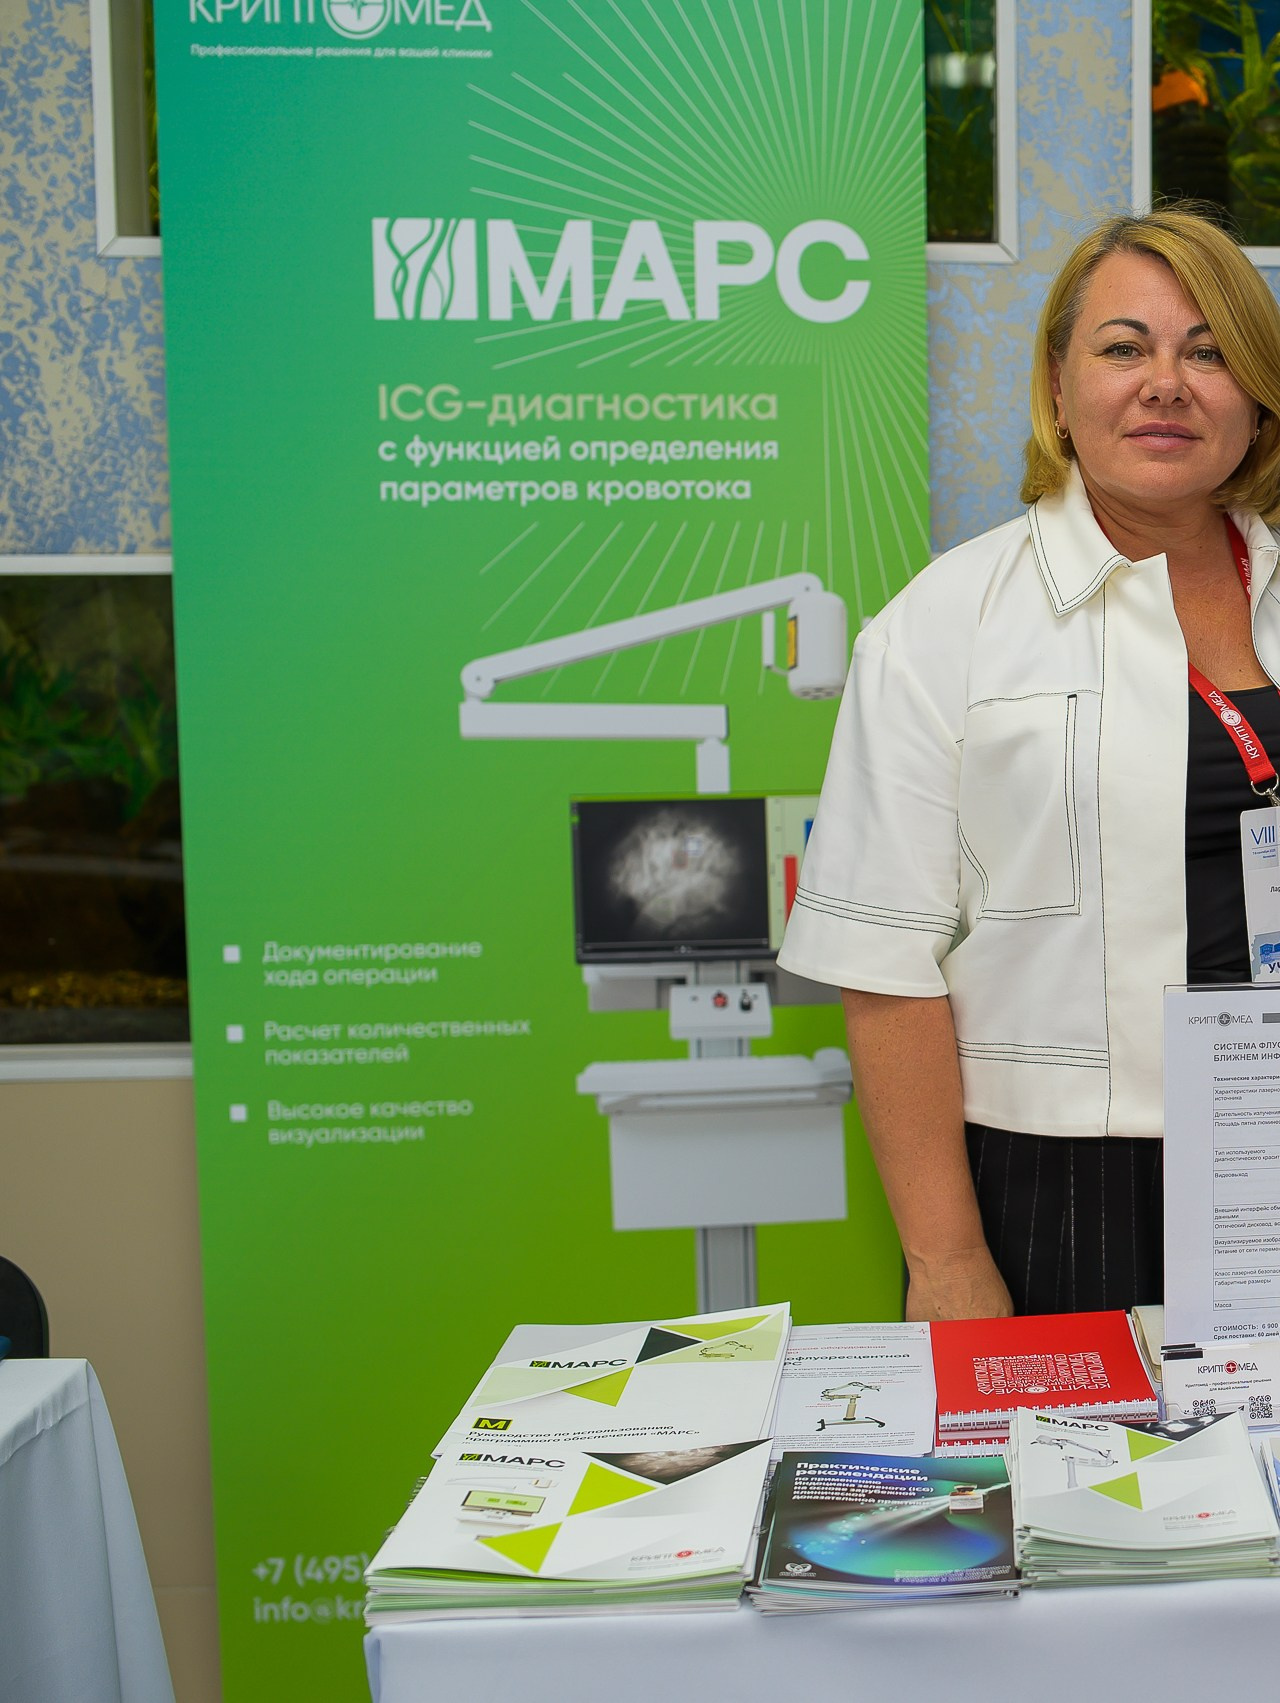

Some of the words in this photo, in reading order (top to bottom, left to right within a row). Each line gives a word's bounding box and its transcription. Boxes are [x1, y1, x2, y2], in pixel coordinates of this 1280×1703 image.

[190, 44, 312, 58] Профессиональные
[316, 46, 371, 57] решения
[374, 47, 396, 58] для
[399, 46, 439, 57] вашей
[442, 47, 493, 58] клиники
[486, 218, 872, 323] МАРС
[378, 383, 778, 428] ICG-диагностика
[378, 439, 396, 461] с
[405, 434, 561, 467] функцией
[569, 439, 779, 467] определения
[380, 479, 578, 507] параметров
[587, 479, 752, 506] кровотока
[1251, 826, 1275, 845] VIII
[262, 941, 483, 965] Документирование
[264, 969, 318, 988] хода
[323, 967, 437, 988] операции
[1188, 1012, 1253, 1026] КРИПТОМЕД
[264, 1021, 342, 1040] Расчет
[347, 1020, 531, 1040] количественных
[1213, 1042, 1256, 1051] СИСТЕМА
[265, 1044, 409, 1066] показателей
[1213, 1053, 1259, 1062] БЛИЖНЕМ
[267, 1100, 364, 1121] Высокое
[370, 1099, 473, 1118] качество
[268, 1126, 425, 1148] визуализации
[1213, 1324, 1259, 1332] СТОИМОСТЬ:
[551, 1358, 628, 1369] МАРС
[785, 1353, 910, 1361] офлуоресцентной
[1197, 1360, 1258, 1374] КРИПТОМЕД
[1212, 1379, 1253, 1387] профессиональные
[573, 1425, 674, 1436] использованию
[1052, 1418, 1109, 1431] МАРС
[465, 1436, 562, 1445] программного
[564, 1432, 648, 1442] обеспечения
[483, 1454, 566, 1468] МАРС
[797, 1462, 920, 1474] Практические
[795, 1470, 928, 1481] рекомендации
[810, 1477, 882, 1485] применению
[849, 1488, 916, 1496] зарубежной
[857, 1483, 907, 1491] зеленого
[791, 1495, 876, 1503] доказательной
[253, 1558, 285, 1584] +7
